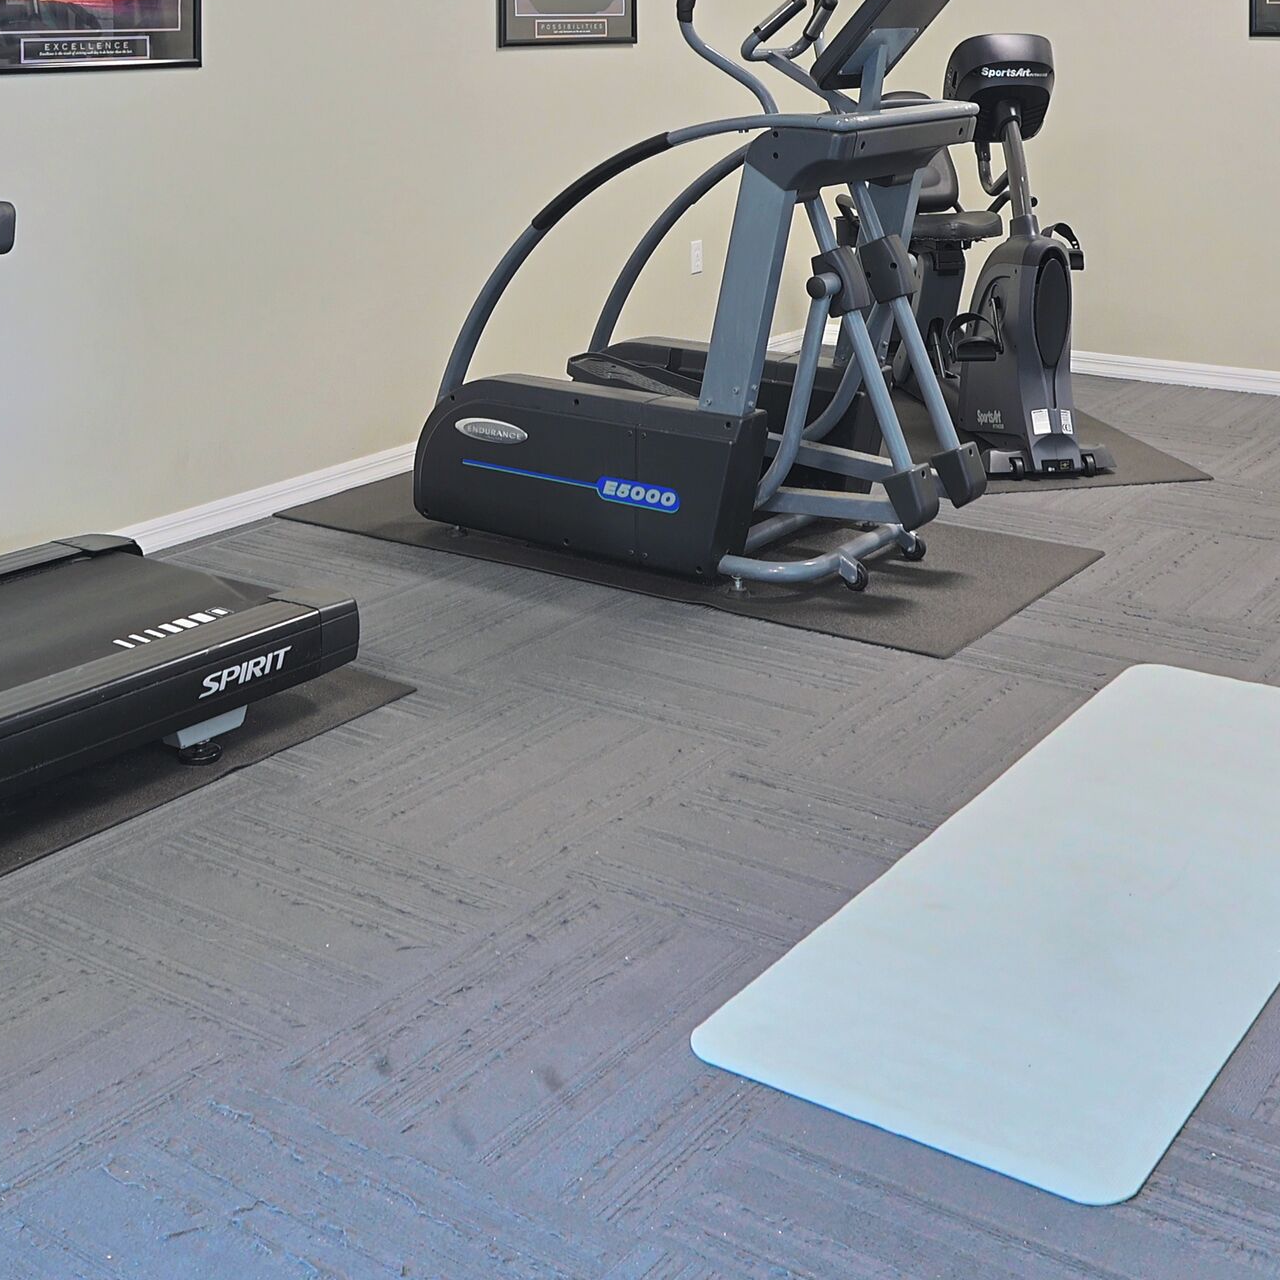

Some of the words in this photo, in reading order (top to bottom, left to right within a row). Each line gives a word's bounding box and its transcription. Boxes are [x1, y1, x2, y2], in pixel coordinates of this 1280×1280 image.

[44, 41, 129, 51] EXCELLENCE
[981, 67, 1031, 78] SportsArt
[977, 409, 1002, 426] SportsArt
[466, 424, 523, 441] ENDURANCE
[603, 480, 676, 507] E5000
[198, 645, 292, 700] SPIRIT
